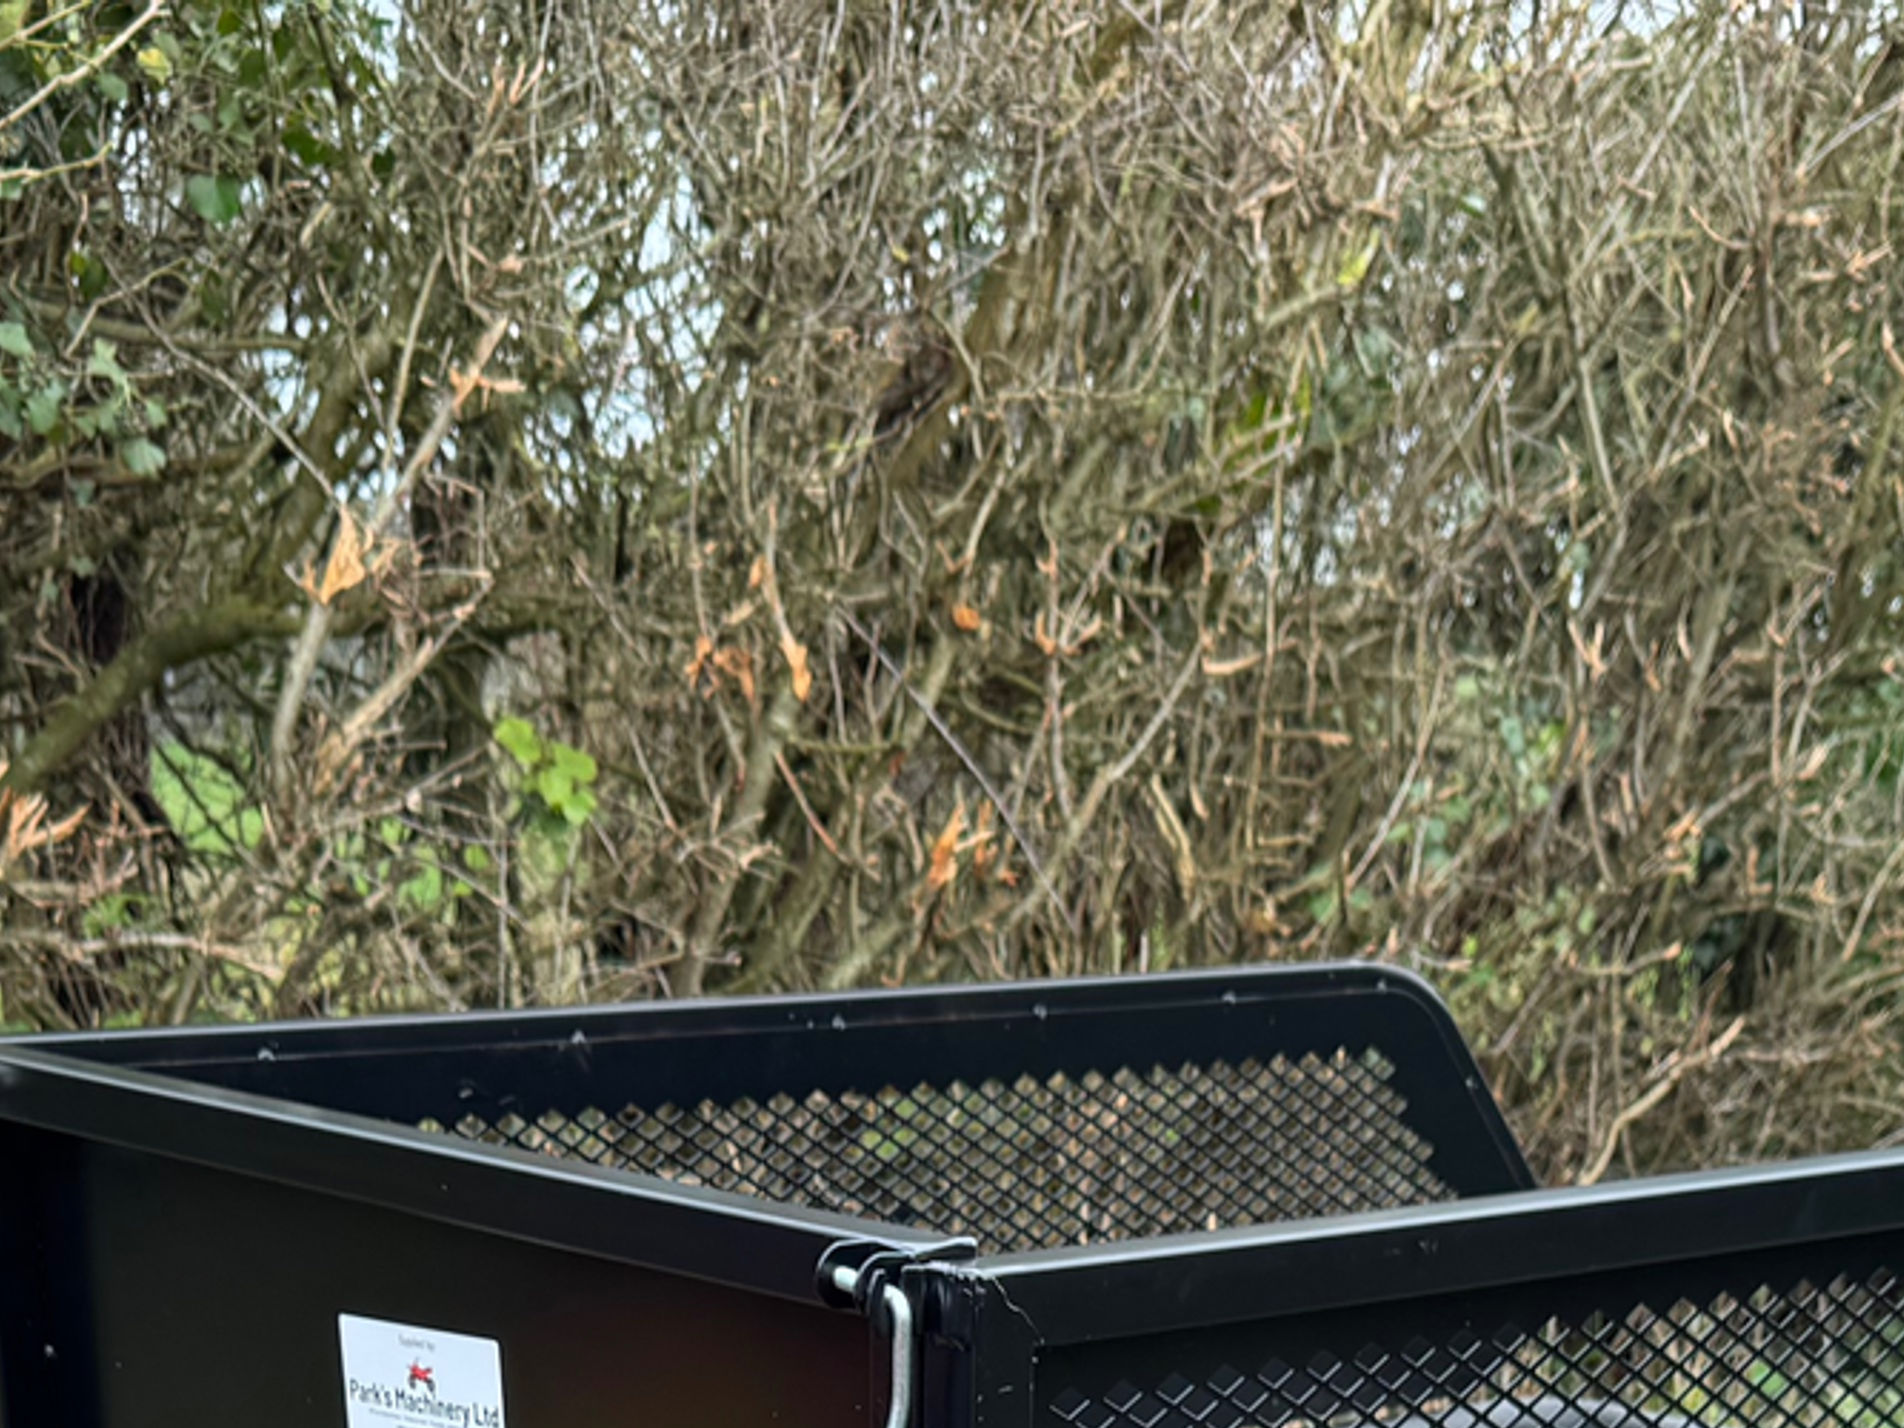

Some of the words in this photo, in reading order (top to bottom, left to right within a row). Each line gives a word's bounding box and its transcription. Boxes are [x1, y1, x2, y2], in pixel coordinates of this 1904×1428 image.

[349, 1378, 393, 1408] Park's
[395, 1388, 470, 1428] Machinery
[473, 1403, 500, 1428] Ltd
